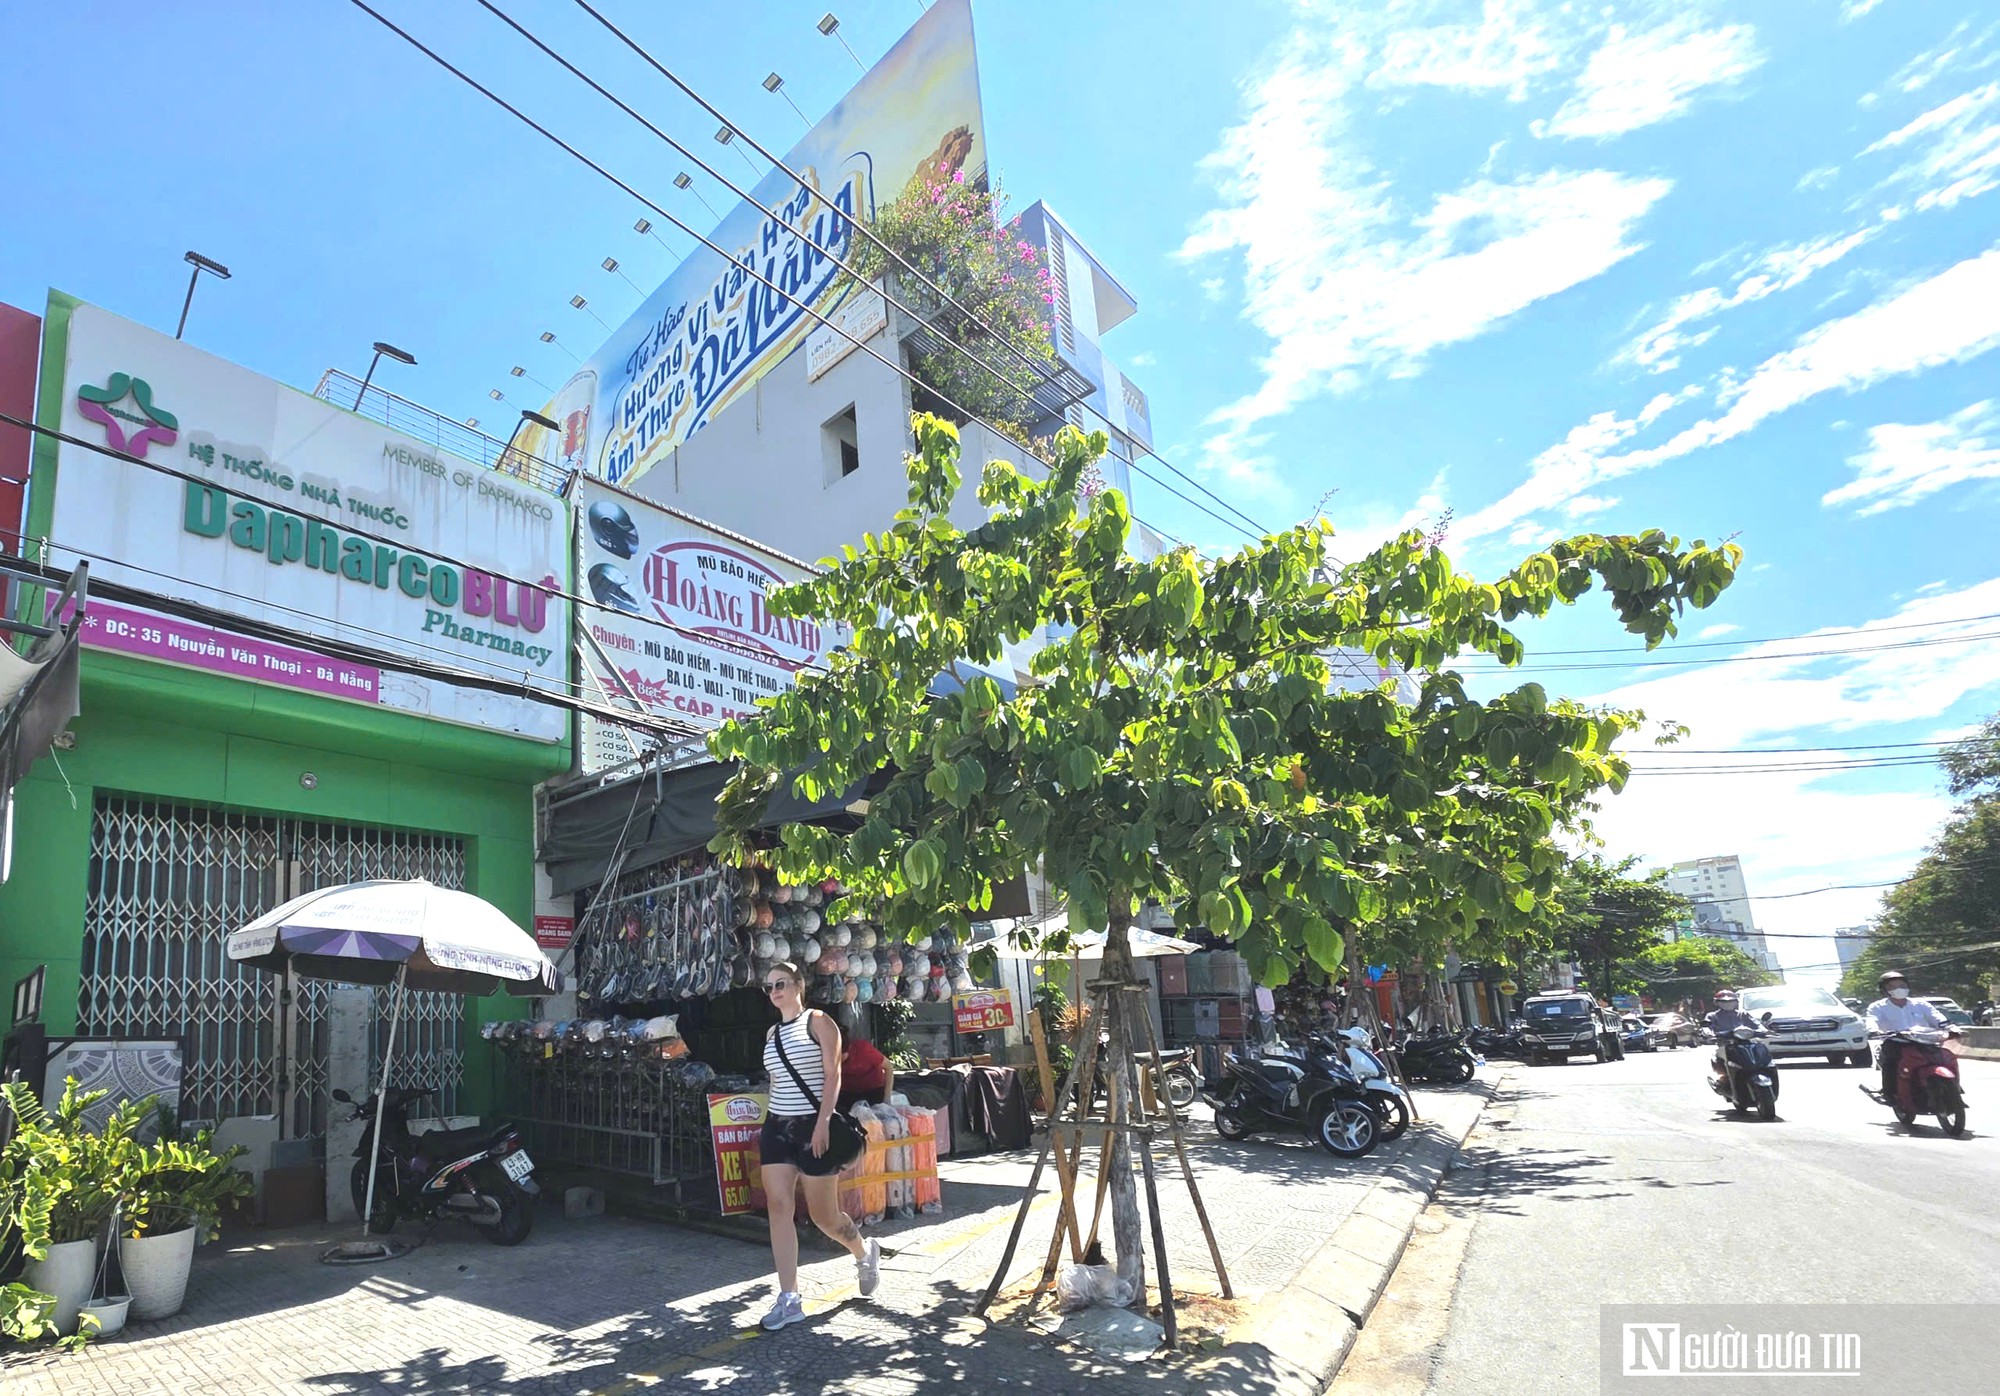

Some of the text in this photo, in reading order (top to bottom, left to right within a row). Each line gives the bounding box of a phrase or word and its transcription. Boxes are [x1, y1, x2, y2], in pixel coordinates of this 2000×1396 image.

[690, 180, 852, 409] Đà Nẵng
[624, 338, 683, 429] Hương
[688, 300, 708, 346] Vị
[714, 250, 755, 314] Văn
[652, 301, 688, 358] Hào
[607, 379, 685, 484] Ẩm Thực
[189, 442, 409, 530] HỆ THỐNG NHÀ THUỐC
[383, 443, 553, 522] MEMBER OF DAPHARCO
[697, 555, 716, 571] MŨ
[720, 559, 744, 579] BẢO
[141, 627, 162, 644] 35
[168, 633, 225, 659] Nguyễn
[231, 648, 257, 666] Văn
[263, 655, 302, 677] Thoại
[316, 666, 334, 682] Đà
[339, 670, 372, 692] Nẵng
[421, 608, 553, 667] Pharmacy
[593, 624, 635, 651] Chuyên
[644, 639, 660, 659] MŨ
[664, 645, 684, 665] BẢO
[687, 651, 711, 674] HIỂM
[720, 662, 734, 680] MŨ
[755, 673, 777, 693] THAO
[667, 669, 681, 687] BA
[684, 673, 695, 690] LÔ
[704, 679, 723, 698] VALI
[732, 687, 747, 704] TÚI
[718, 1129, 736, 1144] BÁN
[721, 1151, 742, 1181] XE
